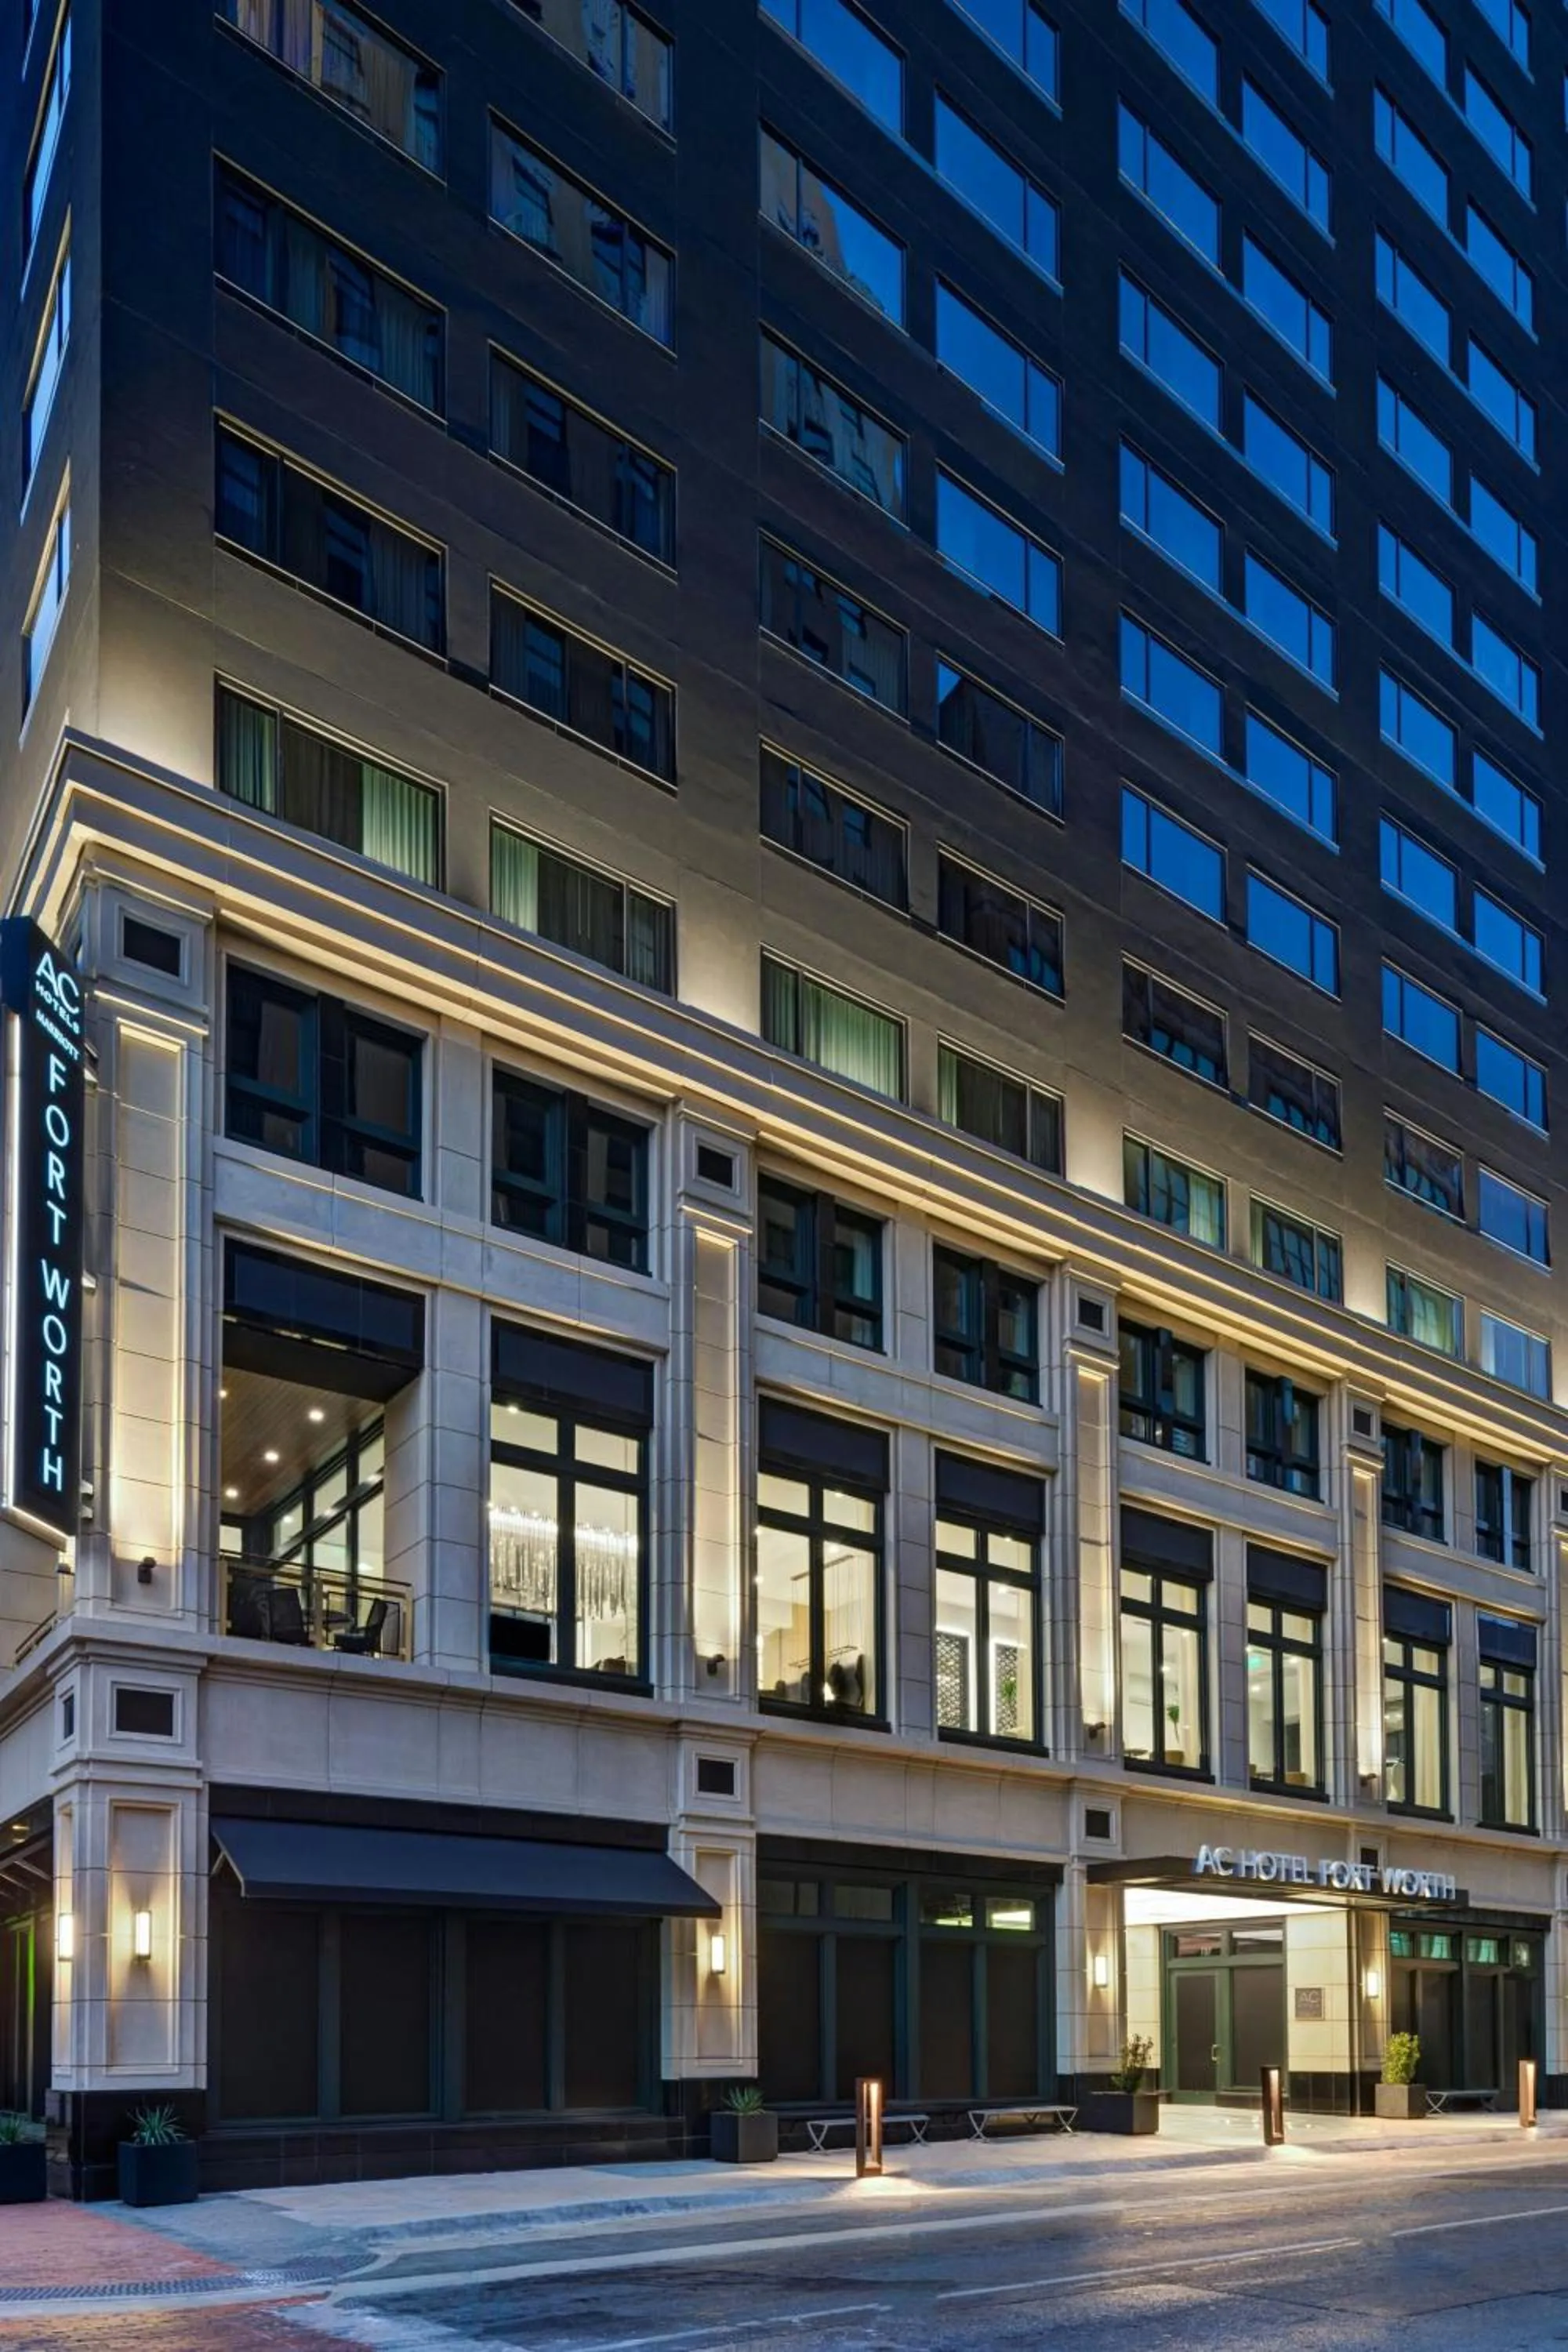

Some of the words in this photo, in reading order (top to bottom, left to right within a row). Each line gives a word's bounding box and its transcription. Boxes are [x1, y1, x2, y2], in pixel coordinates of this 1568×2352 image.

[36, 952, 79, 1014] AC
[36, 980, 80, 1034] HOTELS
[45, 1052, 70, 1244] FORT
[42, 1258, 70, 1491] WORTH
[1196, 1844, 1232, 1875] AC
[1237, 1849, 1314, 1883] HOTEL
[1319, 1859, 1374, 1891] FORT
[1382, 1867, 1455, 1900] WORTH
